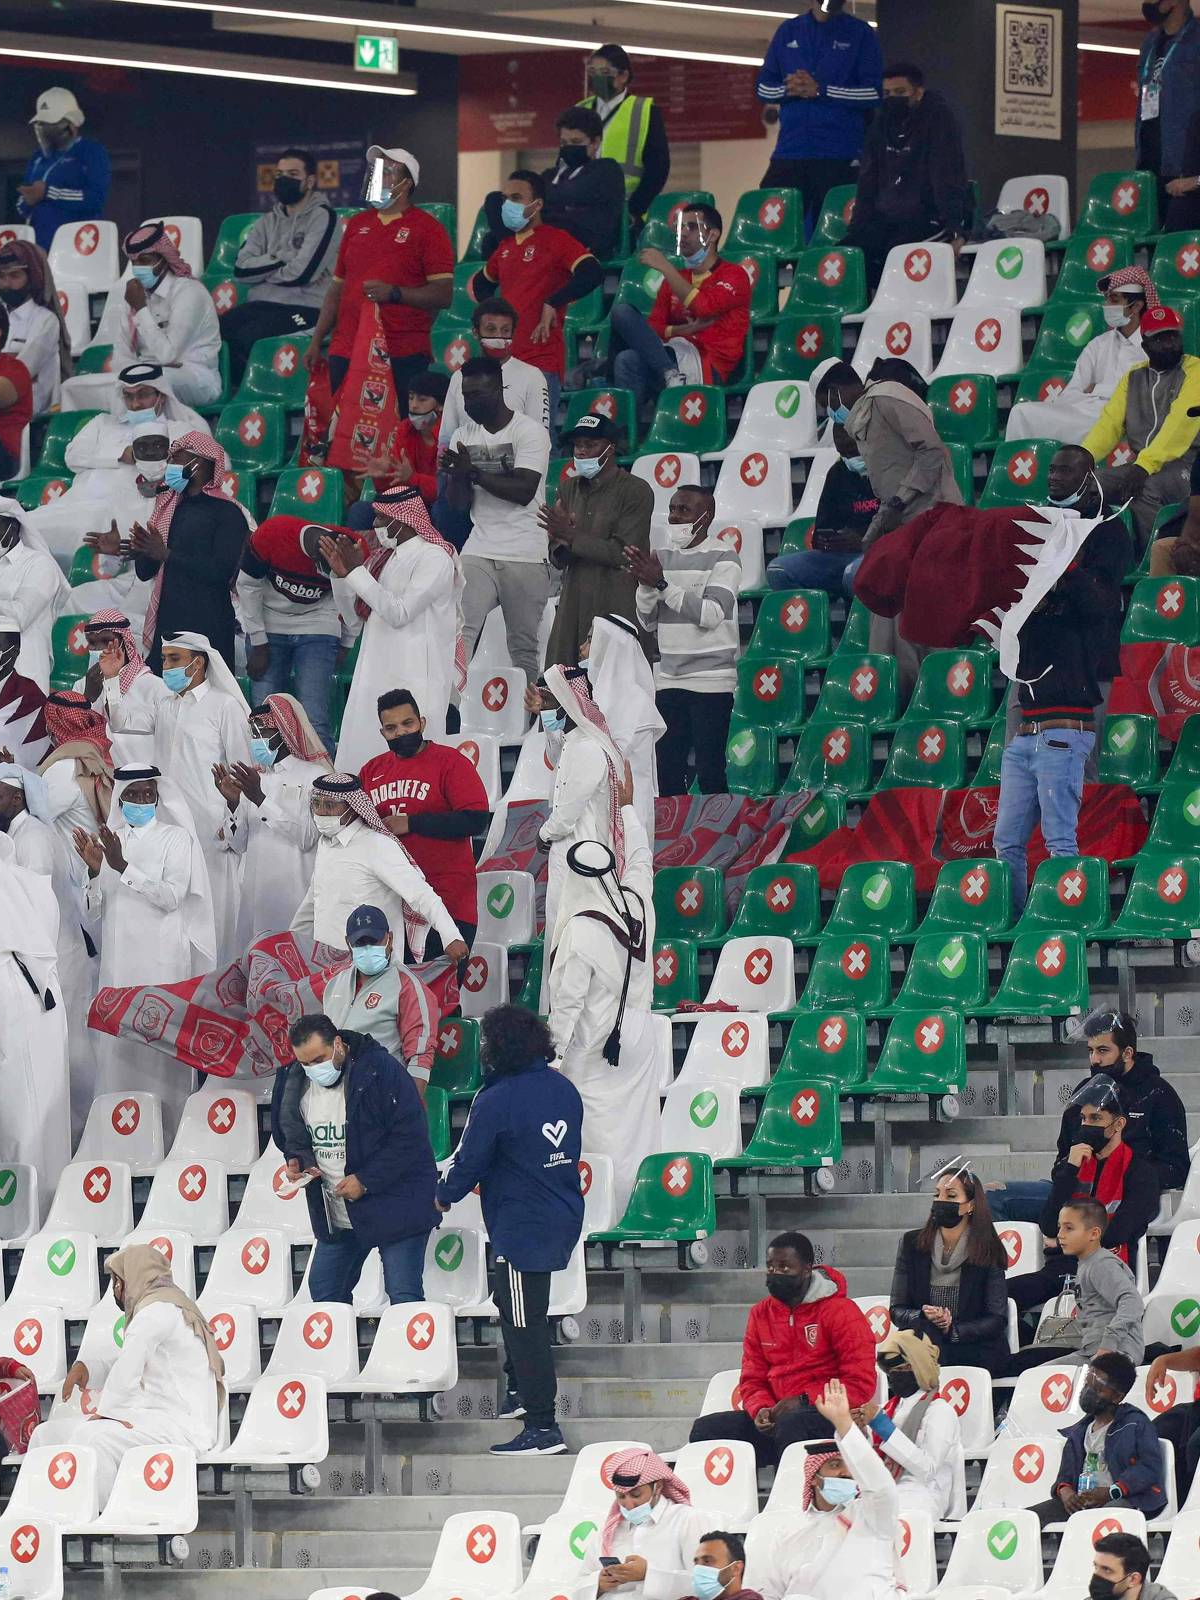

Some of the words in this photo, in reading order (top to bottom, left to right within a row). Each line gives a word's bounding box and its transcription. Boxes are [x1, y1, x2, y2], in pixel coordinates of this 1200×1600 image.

[275, 574, 323, 599] Reebok
[369, 779, 431, 807] ROCKETS
[549, 1151, 566, 1163] FIFA
